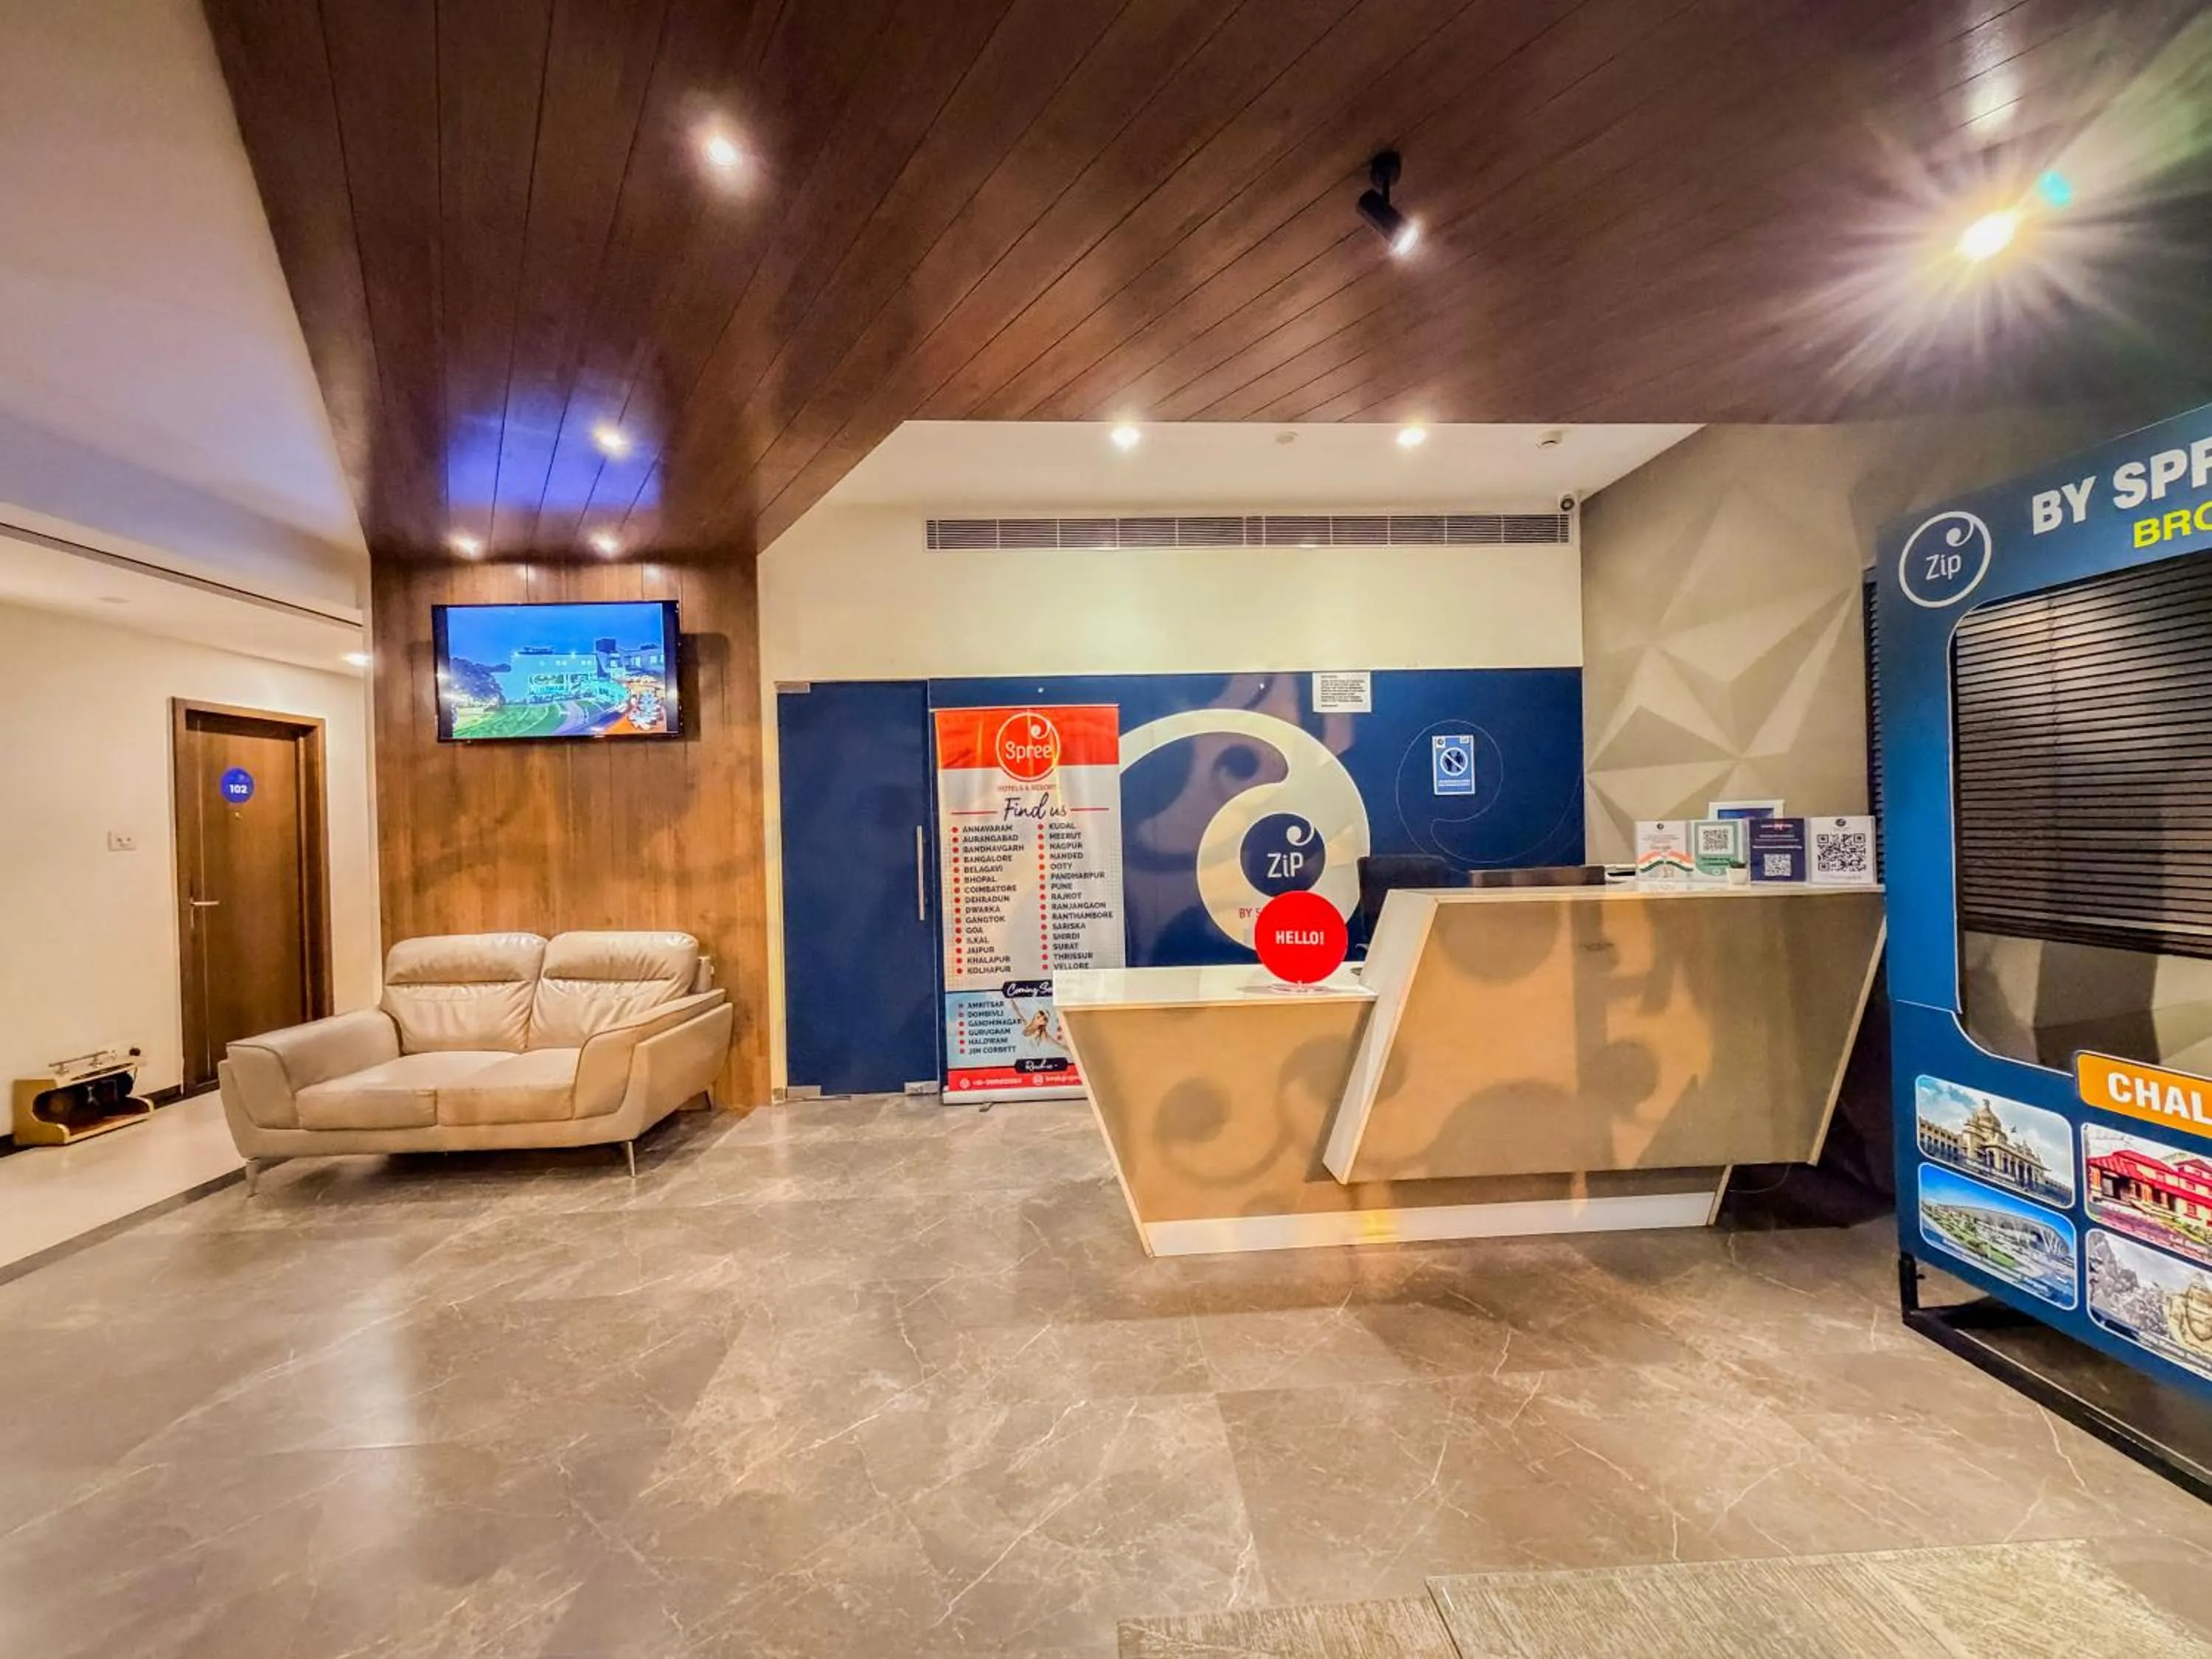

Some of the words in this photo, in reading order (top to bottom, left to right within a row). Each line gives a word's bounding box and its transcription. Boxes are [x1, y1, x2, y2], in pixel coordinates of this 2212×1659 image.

[2032, 476, 2097, 536] BY
[1925, 554, 1961, 581] Zip
[1005, 740, 1051, 764] Spree
[229, 784, 248, 794] 102
[1004, 791, 1049, 821] Find
[1050, 805, 1067, 817] us
[962, 834, 1018, 843] AURANGABAD
[964, 855, 1012, 863] BANGALORE
[1050, 862, 1073, 870] OOTY
[964, 875, 997, 883] BHOPAL
[964, 885, 1017, 894] COIMBATORE
[965, 895, 1010, 903] DEHRADUN
[1051, 892, 1082, 900] RAJKOT
[965, 905, 1001, 914] DWARKA
[1239, 908, 1252, 919] BY
[965, 915, 1005, 924] GANGTOK
[1052, 911, 1113, 919] RANTHAMBORE
[1052, 932, 1079, 940] SHIRDI
[1275, 930, 1324, 945] HELLO!
[967, 946, 995, 954] JAIPUR
[1053, 942, 1079, 950] SURAT
[1053, 952, 1093, 960] THRISSUR
[967, 965, 1011, 974] KOLHAPUR
[1006, 983, 1038, 997] Coming
[967, 1001, 1004, 1009] AMRITSAR
[969, 1047, 981, 1055] JIM
[2108, 1071, 2212, 1125] CHAL
